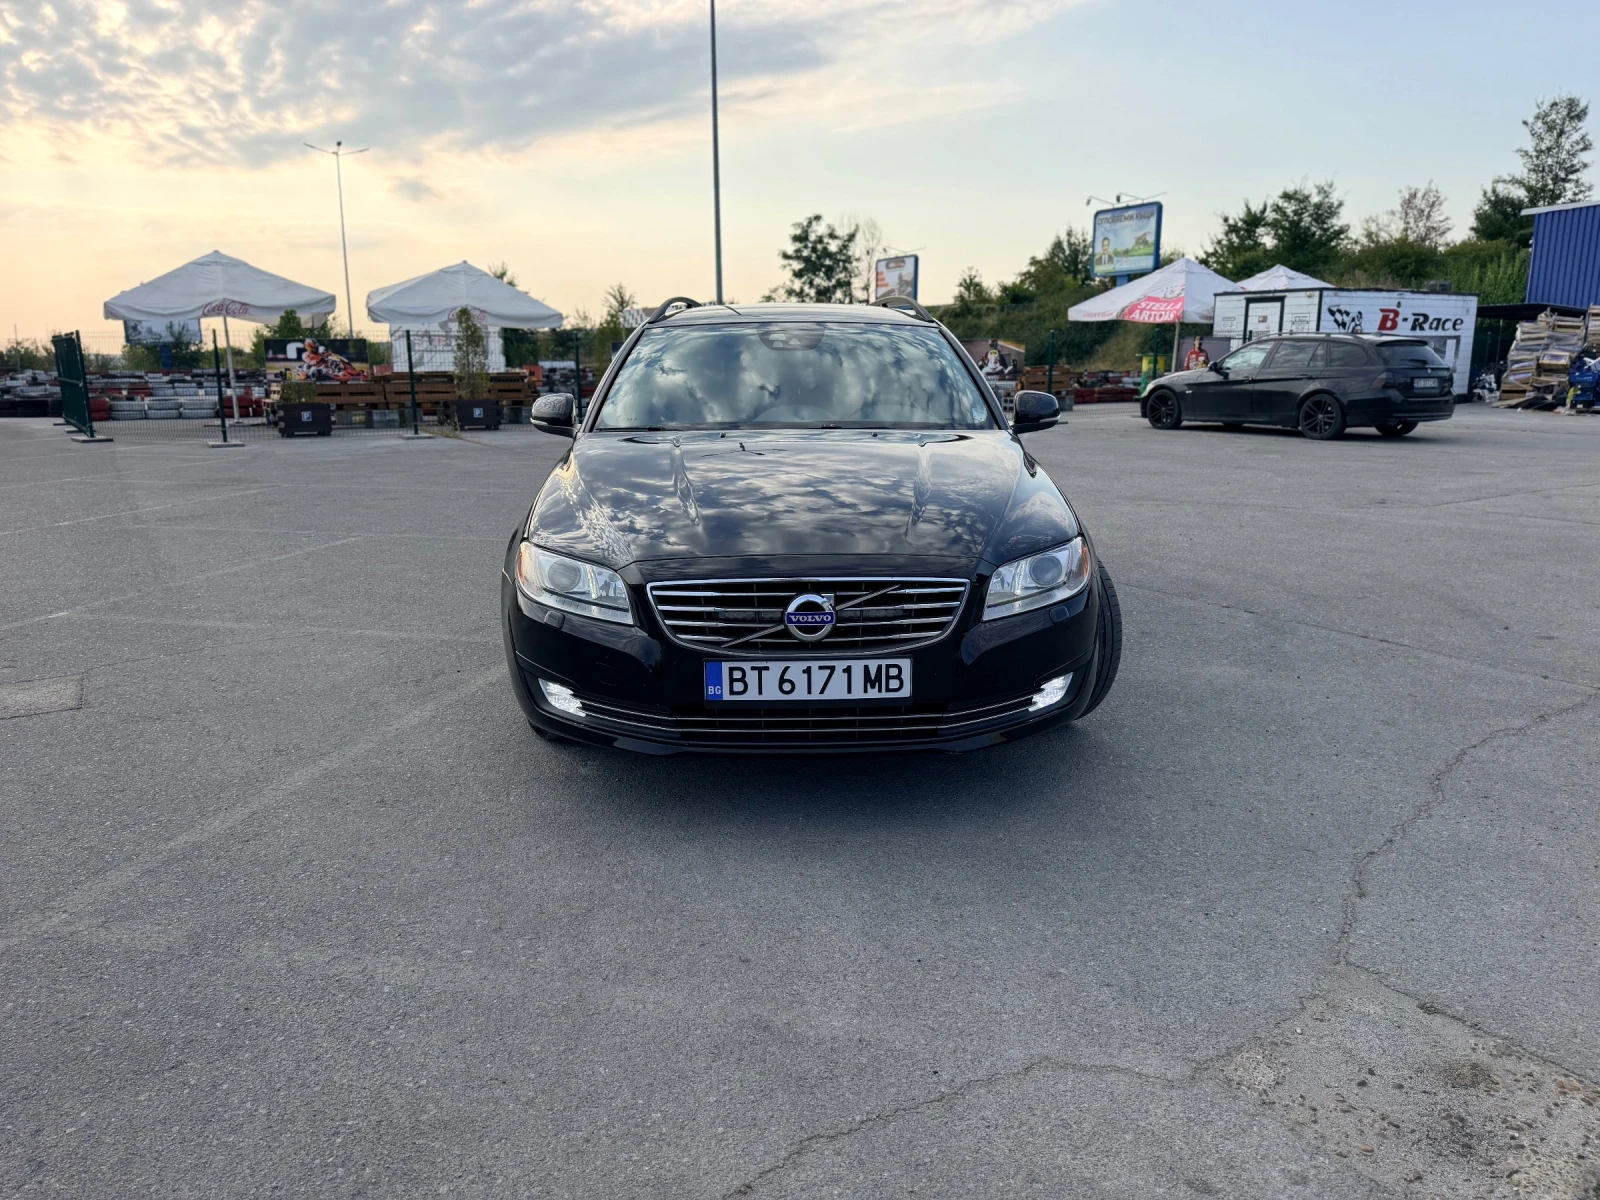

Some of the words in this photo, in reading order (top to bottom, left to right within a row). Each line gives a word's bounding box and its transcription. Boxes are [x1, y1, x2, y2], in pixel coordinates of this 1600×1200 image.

[1137, 301, 1182, 310] STELLA
[1129, 309, 1177, 321] ARTOIS
[789, 614, 832, 622] VOLVO
[728, 665, 770, 696] BT
[778, 664, 853, 695] 6171
[863, 663, 904, 694] MB
[708, 685, 722, 695] BG
